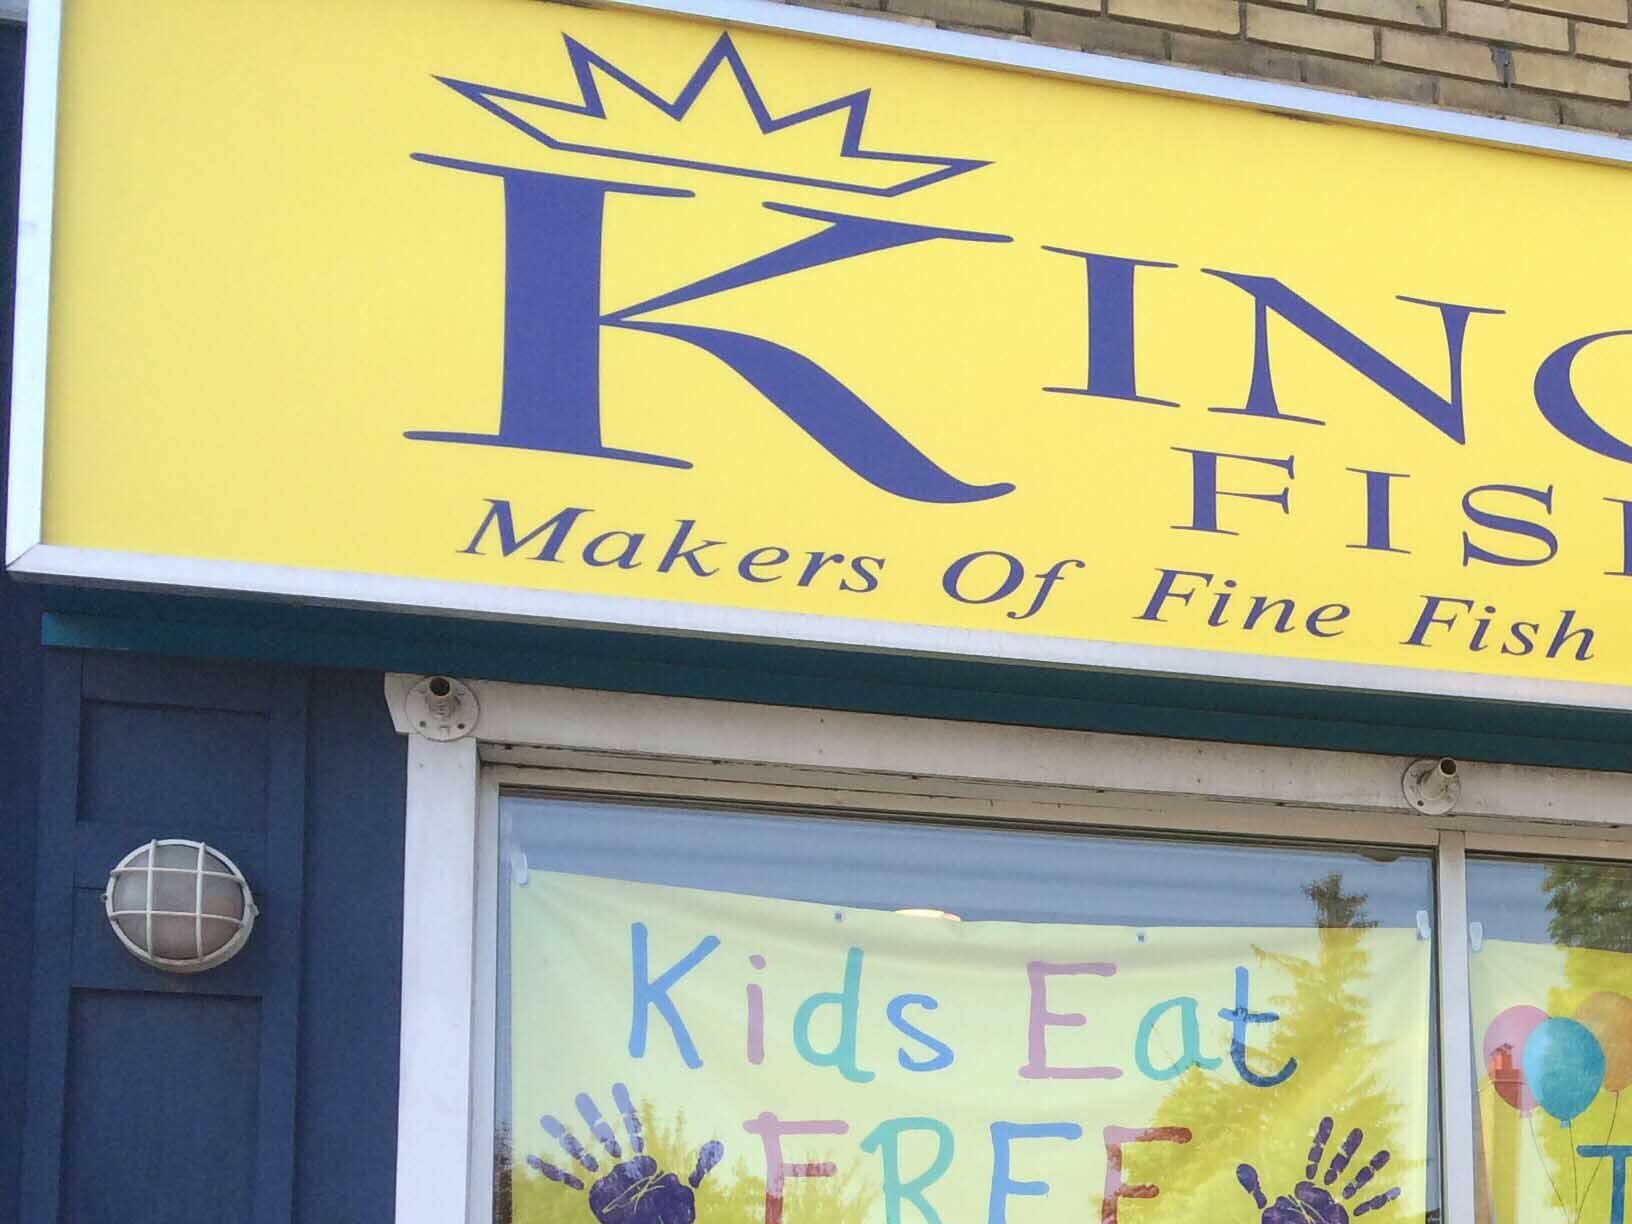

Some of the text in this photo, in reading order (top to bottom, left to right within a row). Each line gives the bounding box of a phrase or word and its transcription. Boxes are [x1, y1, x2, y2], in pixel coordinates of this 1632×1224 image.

[456, 498, 886, 593] Makers
[941, 551, 1085, 620] Of
[1133, 568, 1351, 638] Fine
[1400, 594, 1595, 662] Fish
[628, 922, 1298, 1088] Kids Eat
